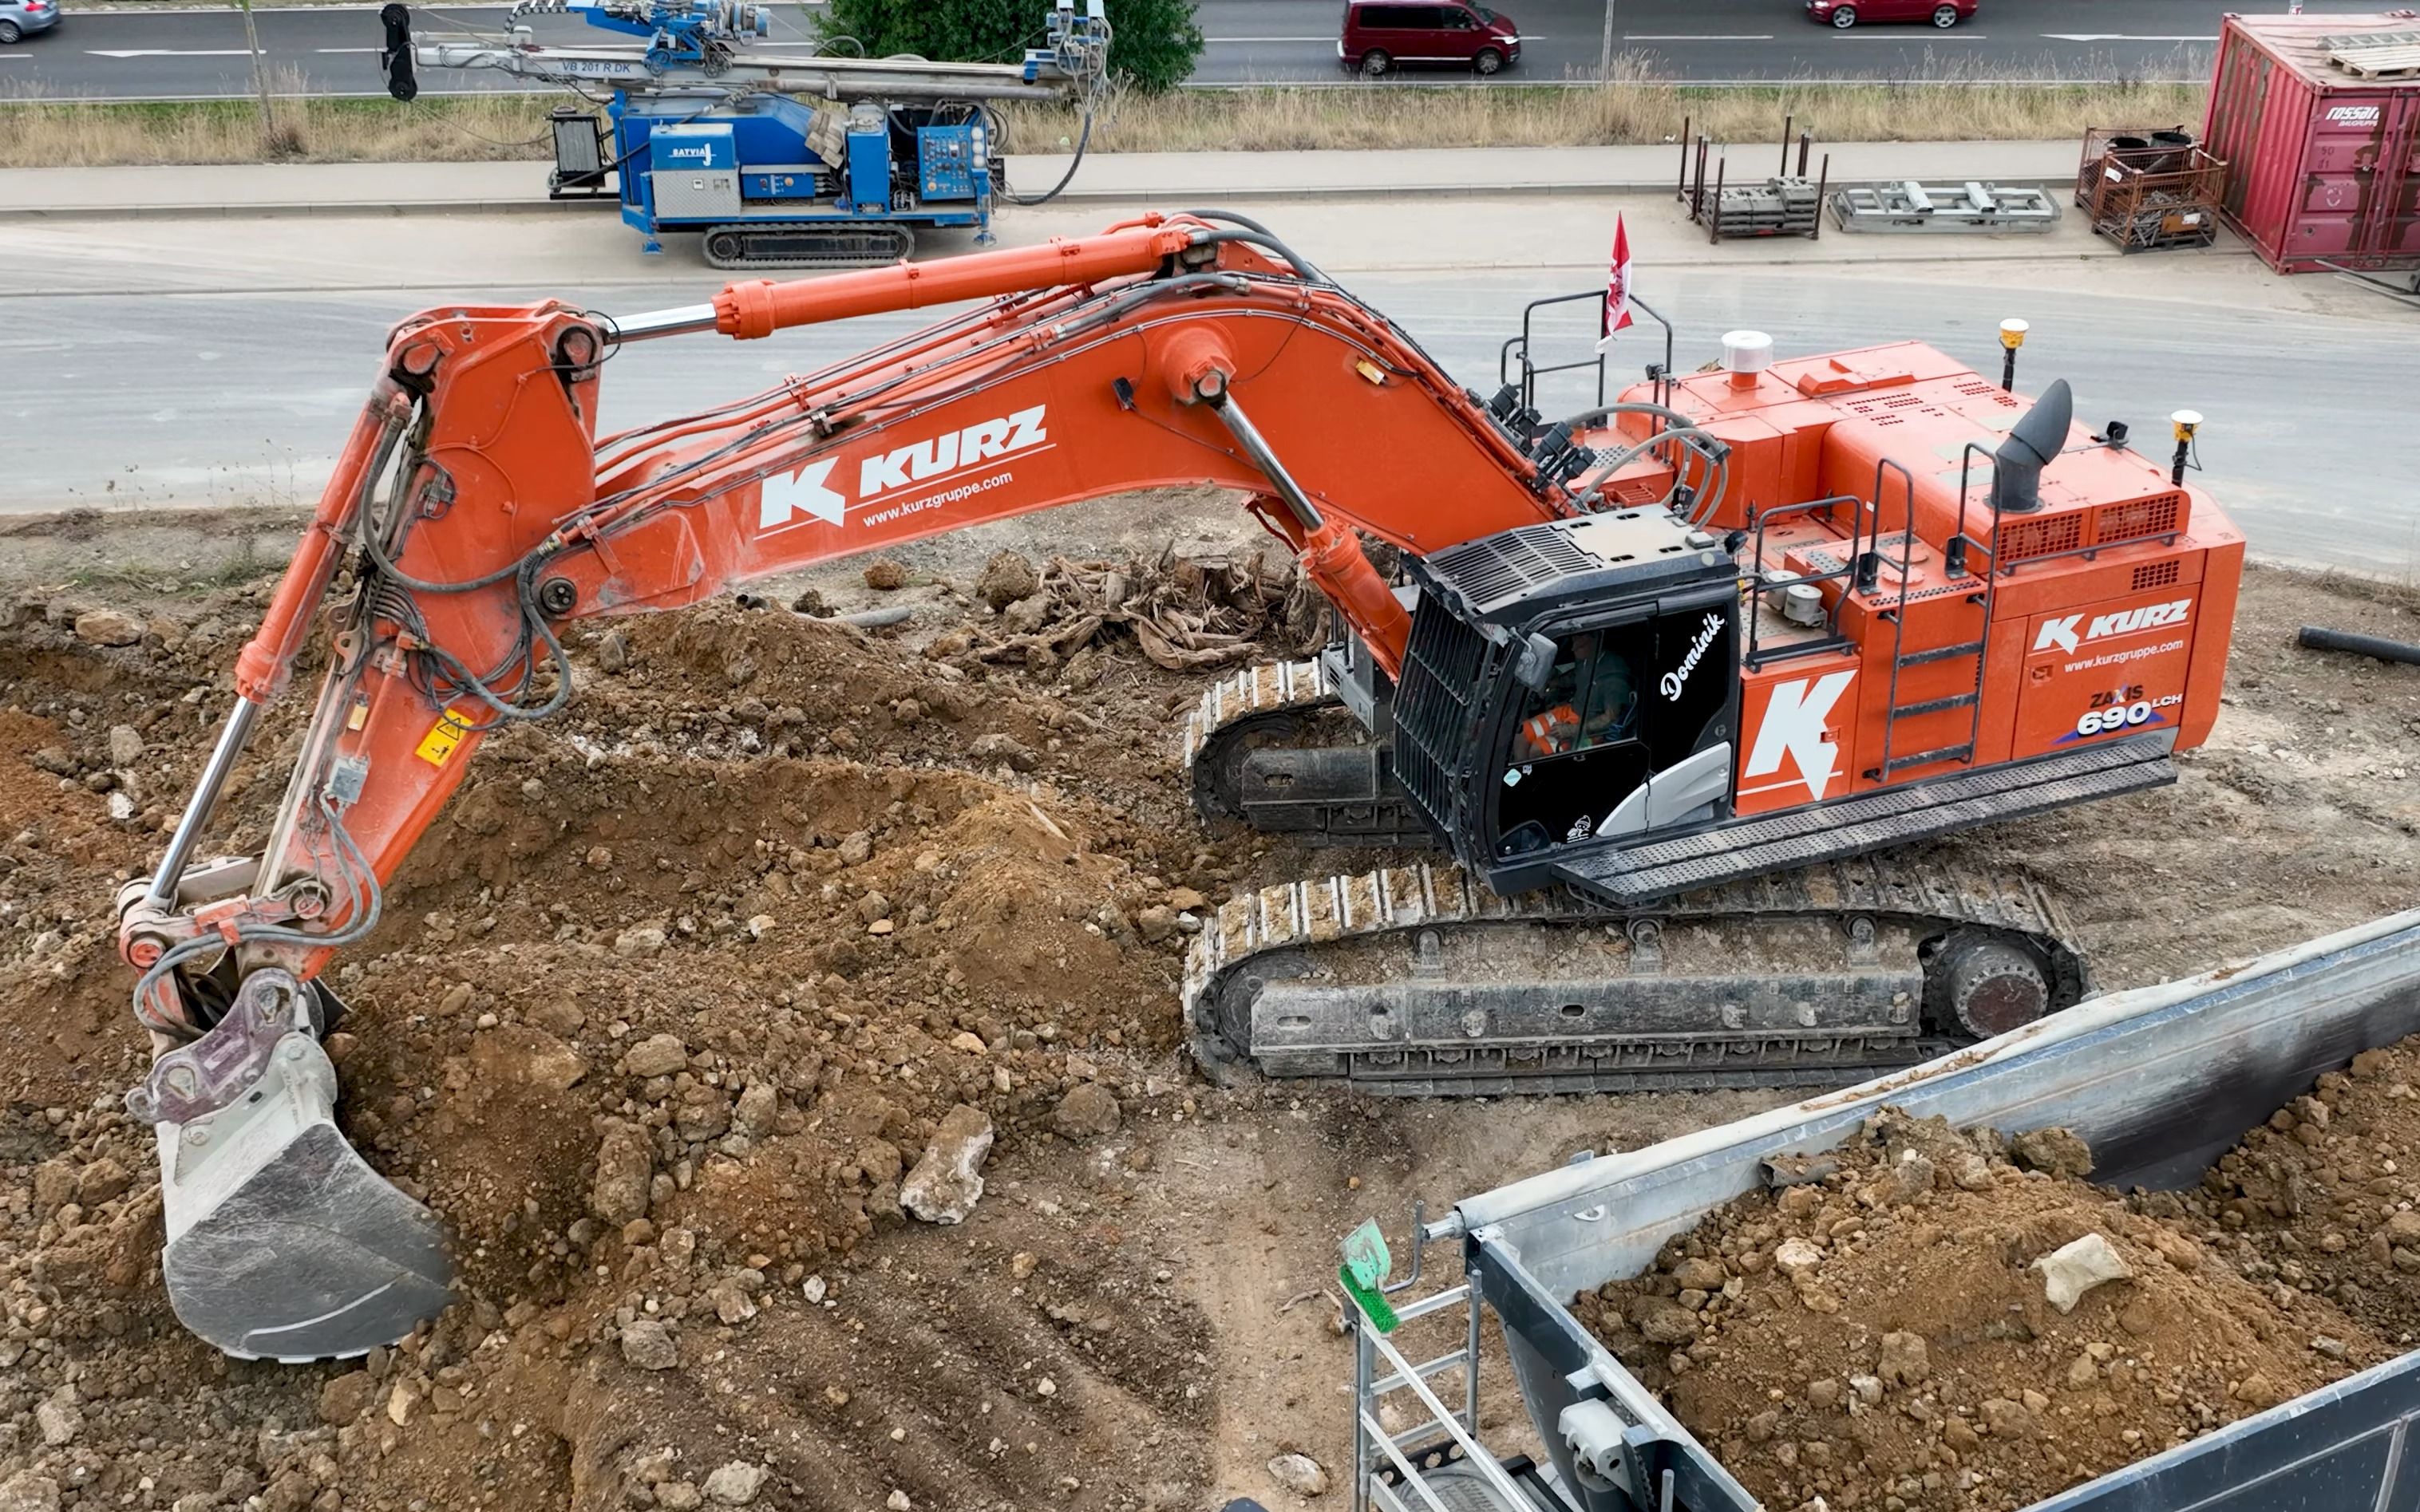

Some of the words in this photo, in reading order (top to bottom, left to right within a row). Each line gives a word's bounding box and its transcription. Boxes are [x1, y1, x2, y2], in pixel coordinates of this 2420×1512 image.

[563, 61, 577, 71] VB
[582, 62, 599, 72] 201
[603, 63, 611, 73] R
[615, 64, 631, 73] DK
[759, 456, 846, 529] K
[859, 404, 1046, 499] KURZ
[863, 470, 1013, 528] www.kurzgruppe.com
[2033, 613, 2086, 656] K
[2086, 598, 2193, 640] KURZ
[1660, 613, 1726, 701] Dominik
[2064, 640, 2184, 673] www.kurzgruppe.com
[2077, 701, 2151, 737] 690
[2152, 693, 2183, 709] LCH
[2090, 683, 2144, 709] ZAXIS
[1744, 669, 1859, 802] K
